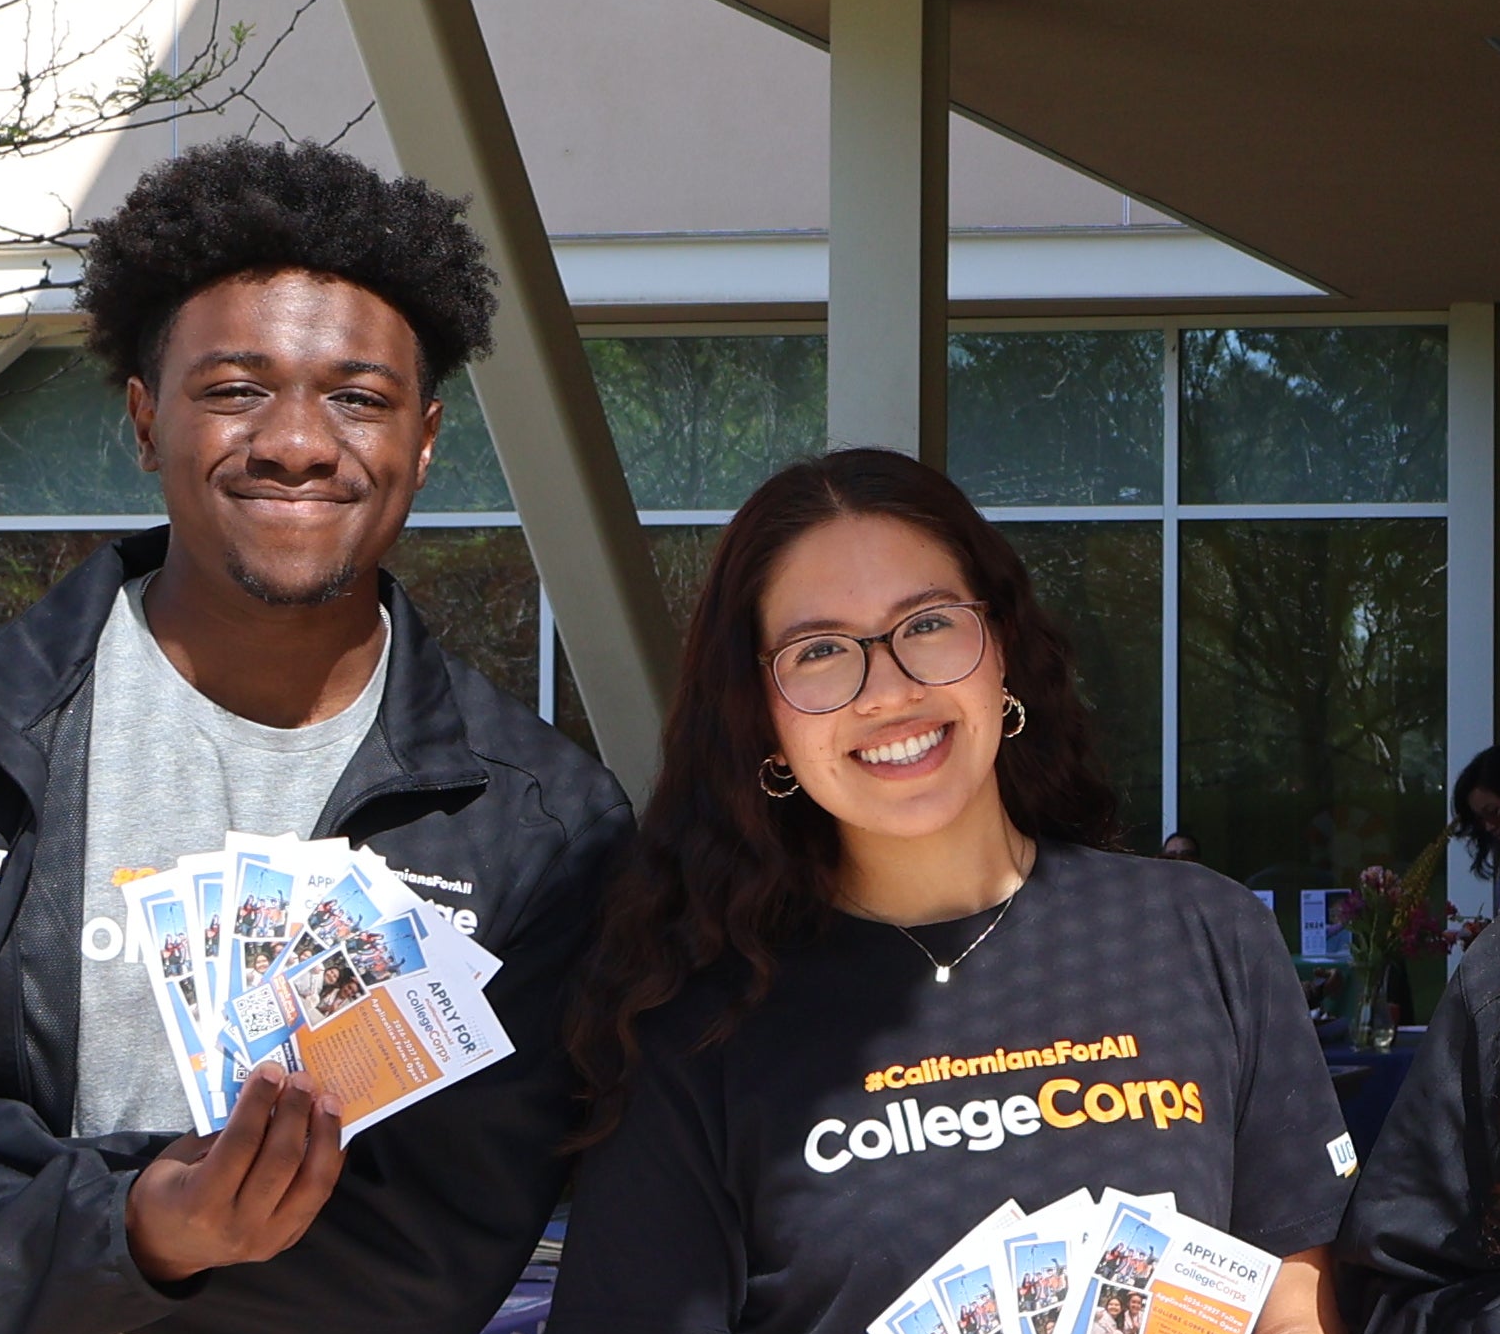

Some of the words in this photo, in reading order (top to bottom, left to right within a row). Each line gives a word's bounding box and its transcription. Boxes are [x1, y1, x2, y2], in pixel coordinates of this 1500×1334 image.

[404, 989, 453, 1063] CollegeCorps
[427, 979, 460, 1023] APPLY
[452, 1024, 476, 1054] FOR
[864, 1035, 1138, 1093] #CaliforniansForAll
[804, 1078, 1202, 1174] CollegeCorps
[1174, 1263, 1246, 1301] CollegeCorps
[1183, 1242, 1227, 1266] APPLY
[1229, 1261, 1257, 1281] FOR
